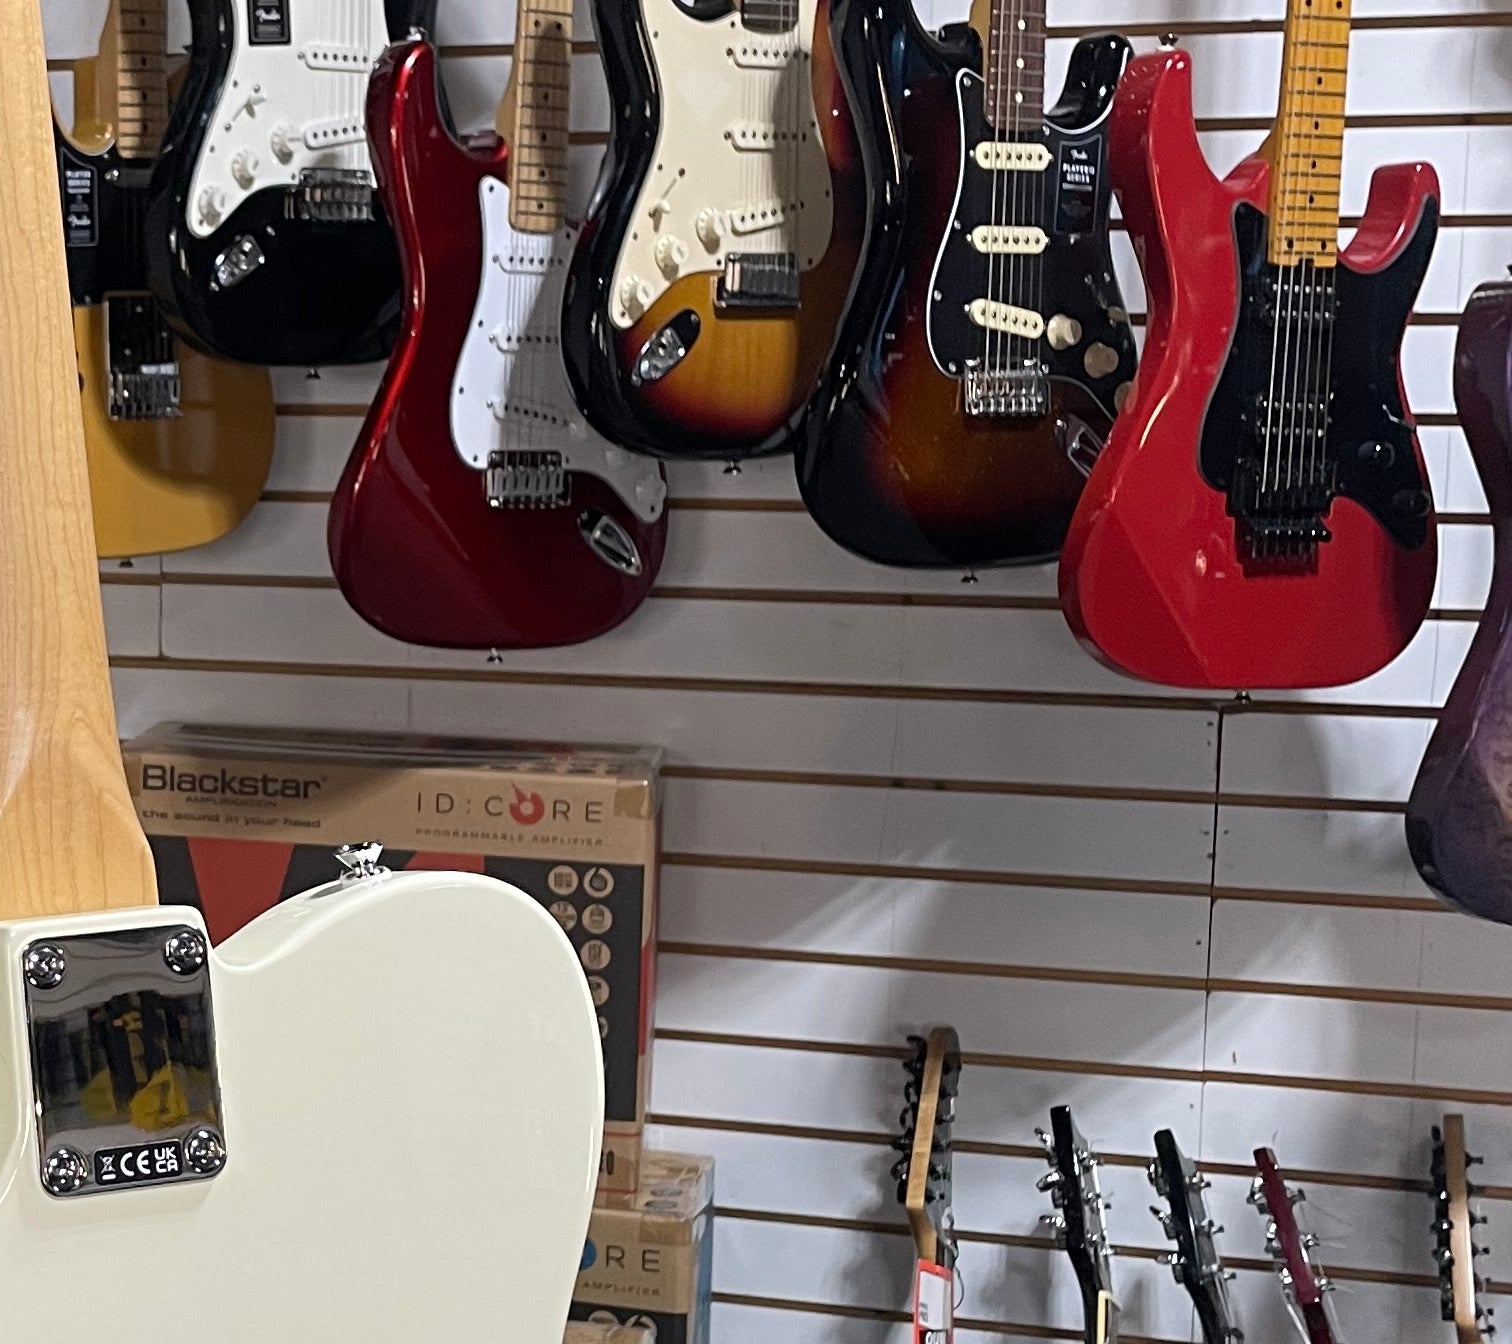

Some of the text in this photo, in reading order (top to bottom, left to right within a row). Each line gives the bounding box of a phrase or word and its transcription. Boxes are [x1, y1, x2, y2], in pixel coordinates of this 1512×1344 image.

[142, 764, 322, 800] Blackstar
[142, 810, 169, 819] the
[174, 813, 220, 823] sound
[283, 817, 321, 828] head
[154, 1146, 176, 1160] UK
[155, 1159, 178, 1174] CA
